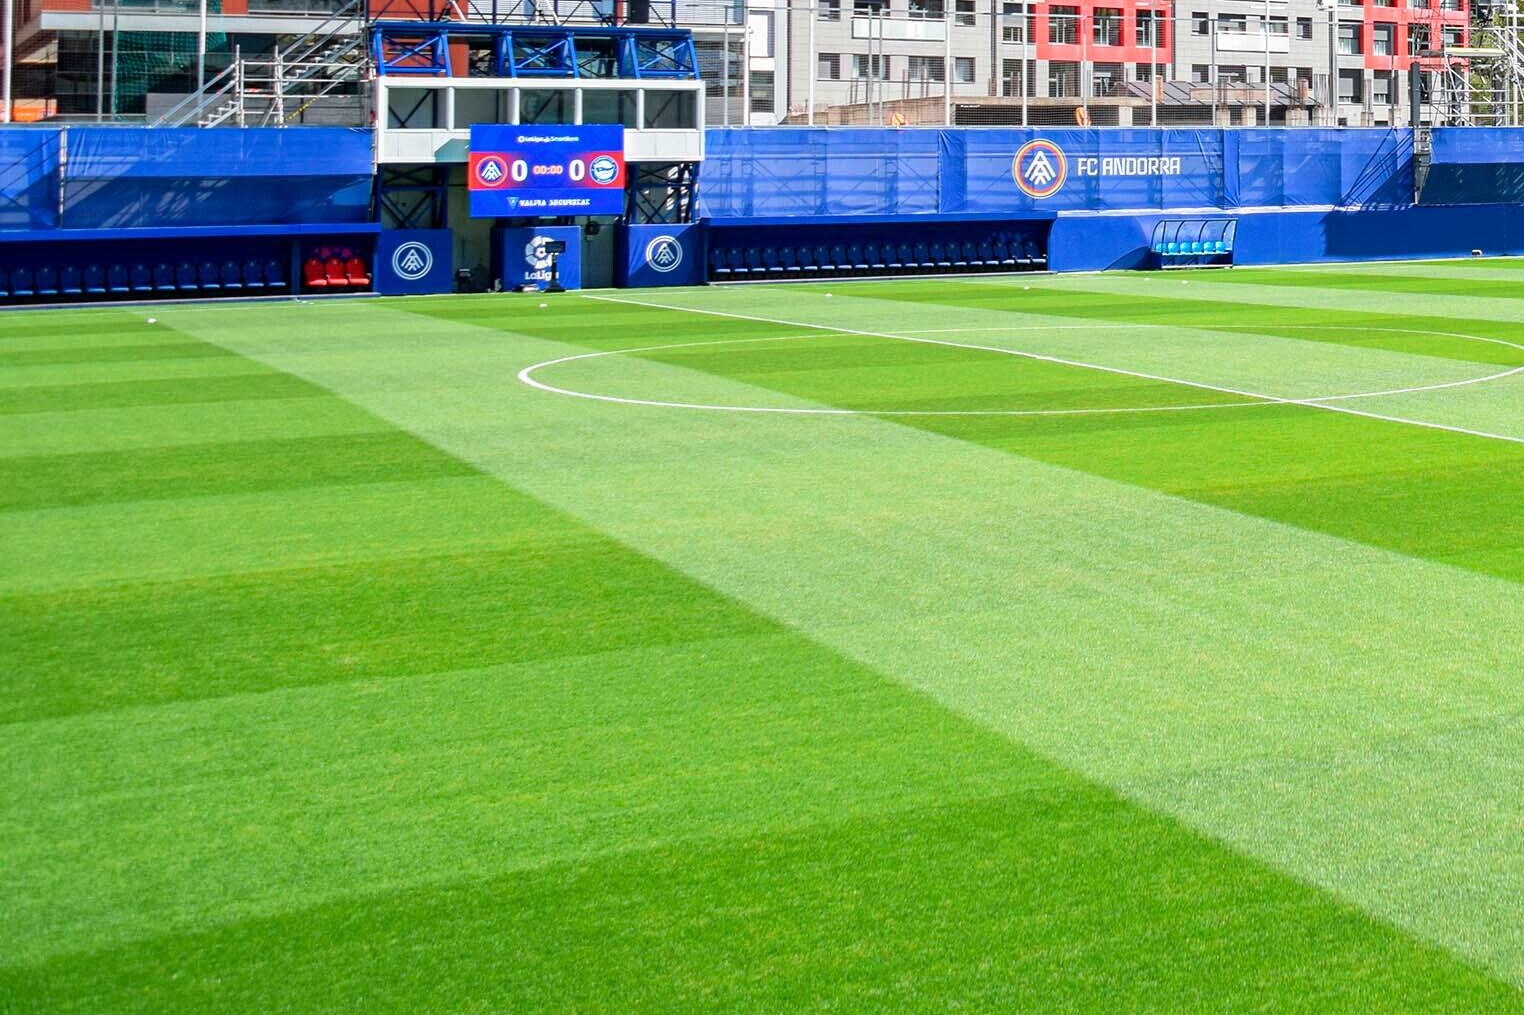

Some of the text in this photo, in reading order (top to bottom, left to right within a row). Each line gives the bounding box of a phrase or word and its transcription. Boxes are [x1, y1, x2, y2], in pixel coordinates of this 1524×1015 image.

[511, 160, 528, 181] 0
[533, 165, 563, 175] 00:00
[569, 160, 585, 181] 0
[1078, 157, 1181, 176] FC ANDORRA
